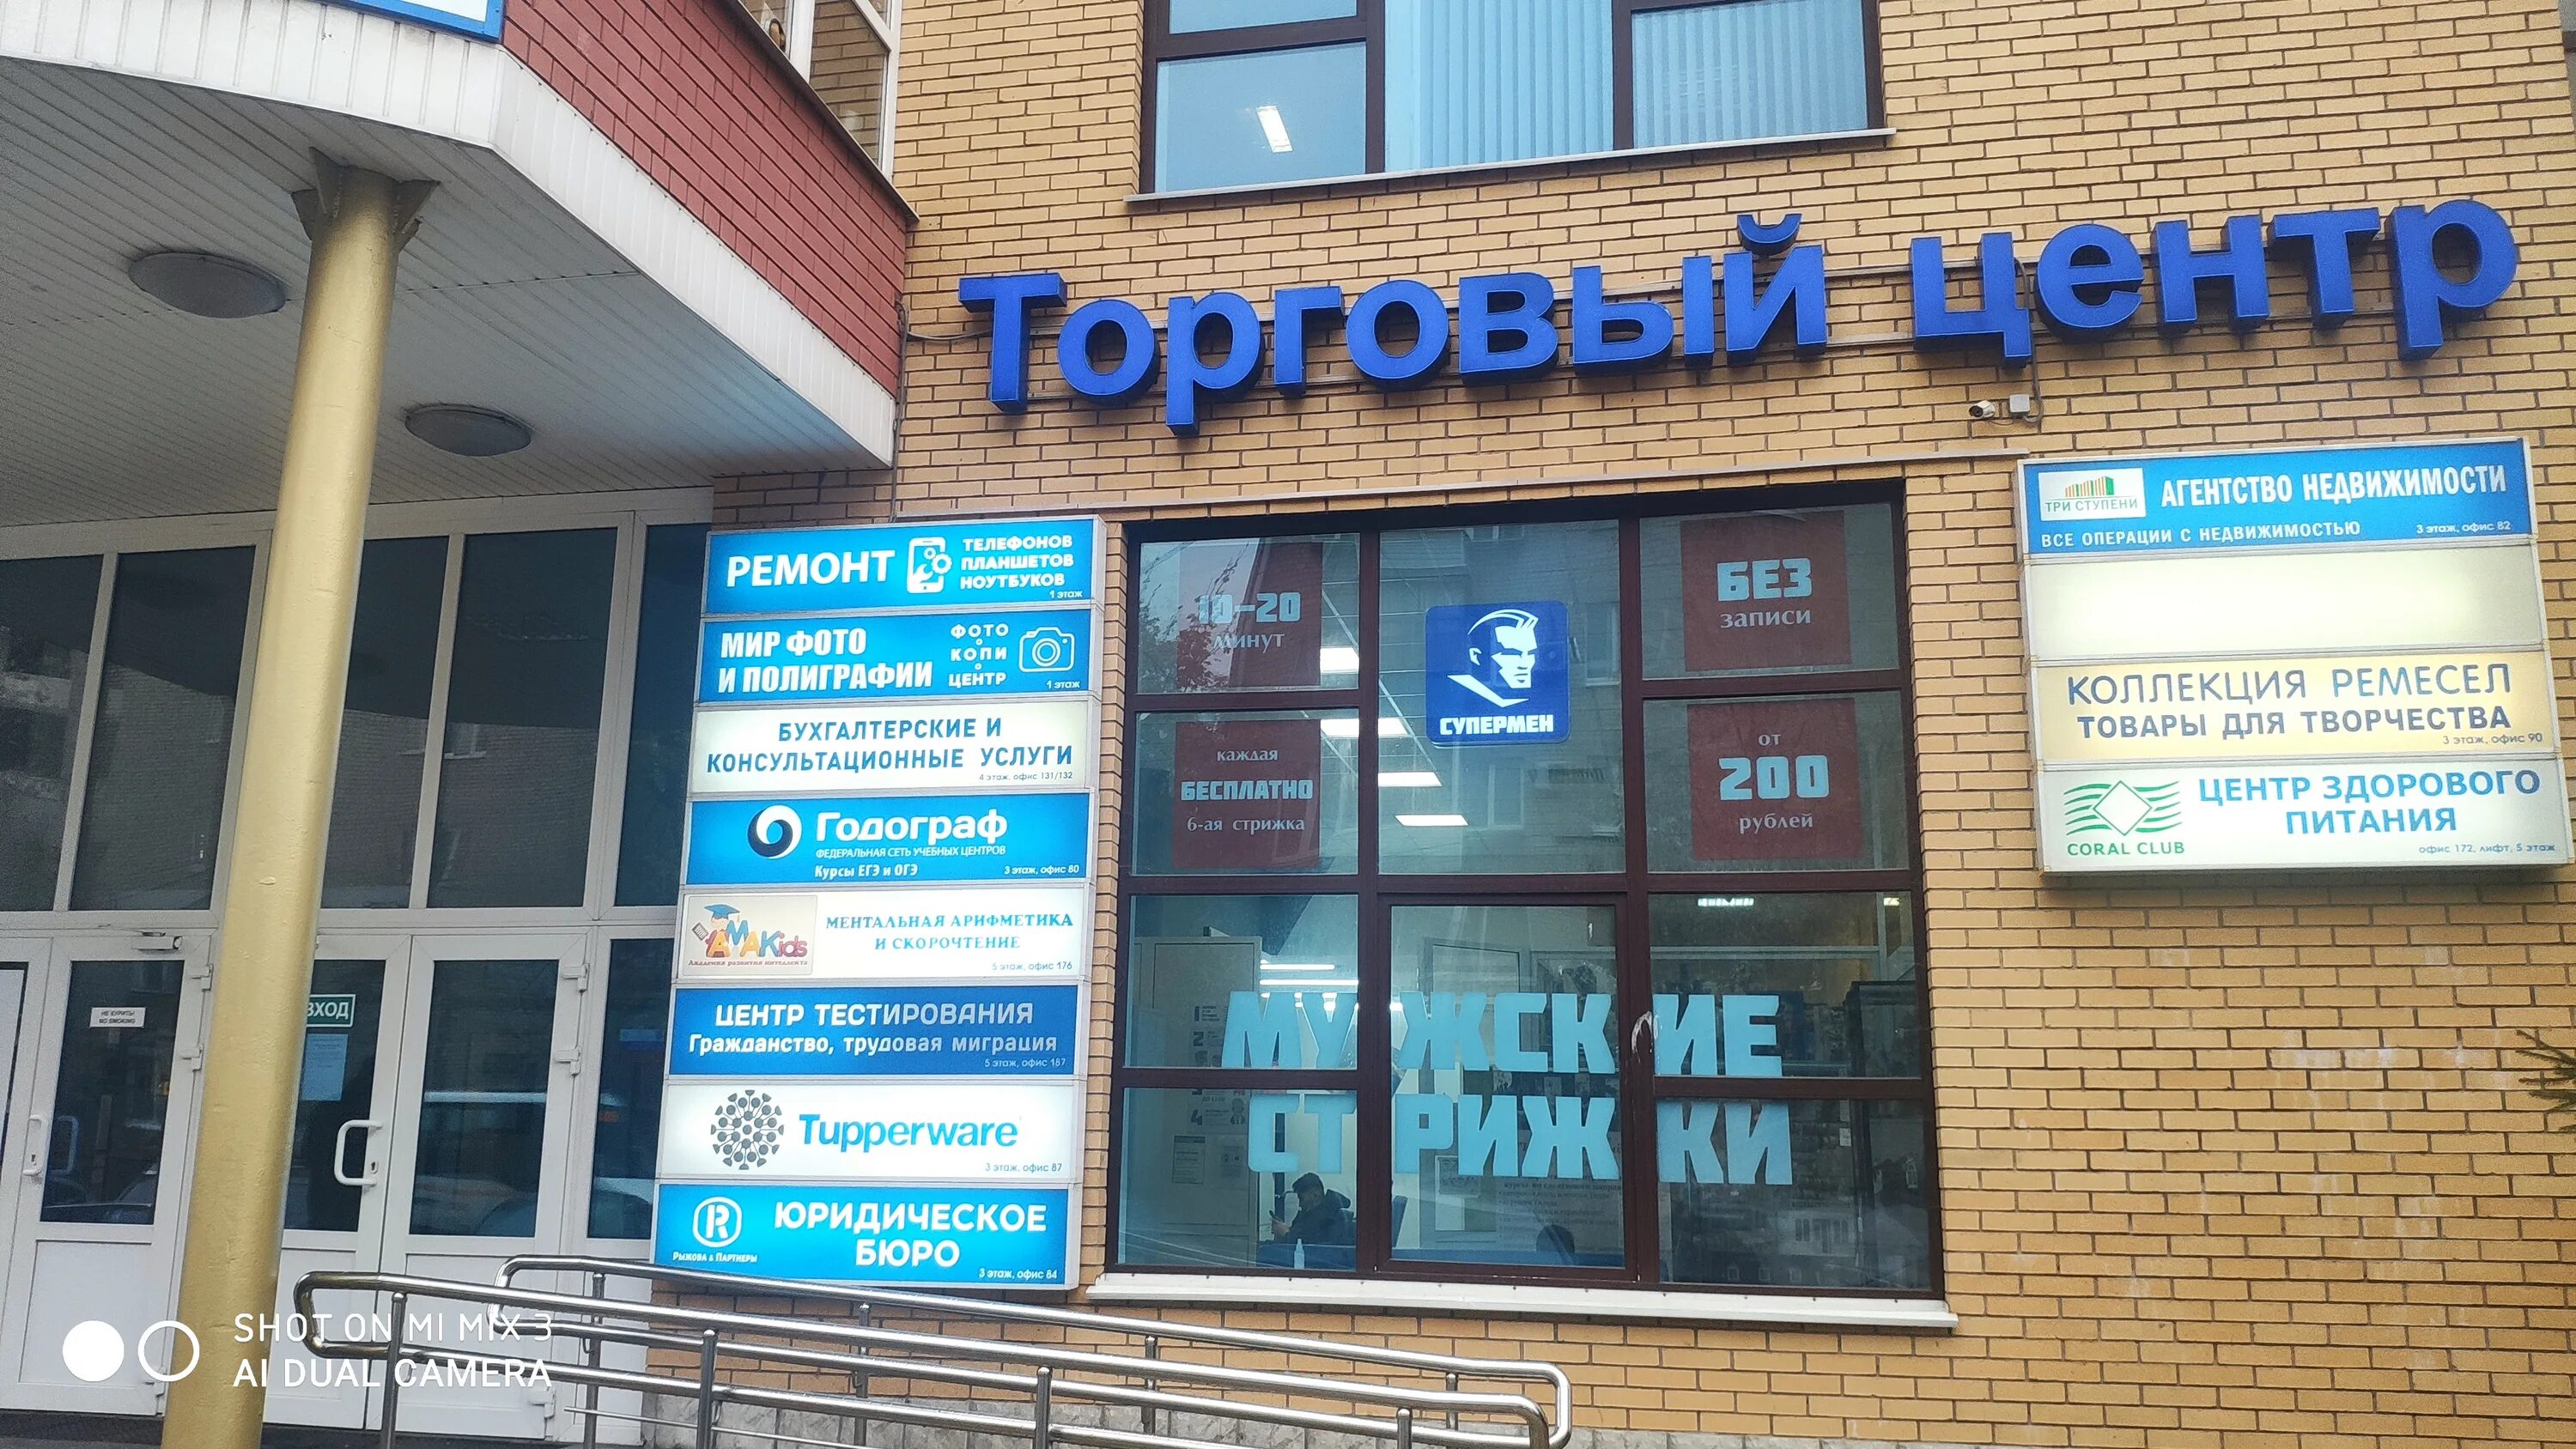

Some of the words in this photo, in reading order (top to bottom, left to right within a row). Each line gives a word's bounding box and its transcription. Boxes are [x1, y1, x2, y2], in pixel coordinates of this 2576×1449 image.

[958, 213, 1828, 436] Торговый
[1911, 198, 2519, 361] центр
[2160, 473, 2293, 508] АГЕНТСТВО
[2303, 465, 2507, 504] НЕДВИЖИМОСТИ
[2044, 500, 2072, 512] ТРИ
[2075, 496, 2139, 512] СТУПЕНИ
[2040, 533, 2075, 548] ВСЕ
[2082, 529, 2173, 548] ОПЕРАЦИИ
[2181, 528, 2192, 542] С
[2199, 520, 2361, 543] НЕДВИЖИМОСТЬЮ
[2416, 524, 2423, 534] 3
[2426, 524, 2459, 533] этаж,
[2462, 522, 2495, 532] офис
[963, 535, 1073, 552] ТЕЛЕФОНОВ
[726, 550, 896, 587] РЕМОНТ
[960, 554, 1074, 571] ПЛАНШЕТОВ
[960, 573, 1066, 590] НОУТБУКОВ
[1717, 558, 1813, 602] БЕЗ
[1049, 590, 1055, 598] 1
[1057, 590, 1084, 599] этаж
[1720, 609, 1811, 628] записи
[951, 623, 1010, 639] ФОТО
[721, 632, 781, 658] МИР
[787, 627, 866, 656] ФОТО
[1213, 634, 1285, 654] минут
[951, 646, 1008, 662] КОПИ
[718, 667, 736, 694] И
[742, 661, 933, 693] ПОЛИГРАФИИ
[948, 671, 1007, 688] ЦЕНТР
[1046, 681, 1053, 689] 1
[1054, 680, 1080, 689] этаж
[2068, 670, 2306, 705] КОЛЛЕКЦИЯ
[2332, 664, 2511, 698] РЕМЕСЕЛ
[778, 718, 975, 742] БУХГАЛТЕРСКИЕ
[986, 718, 1001, 736] И
[1440, 713, 1554, 736] СУПЕРМЕН
[2077, 713, 2207, 739] ТОВАРЫ
[2222, 712, 2285, 740] ДЛЯ
[2301, 706, 2512, 735] ТВОРЧЕСТВА
[1758, 734, 1782, 747] от
[2443, 736, 2450, 745] 3
[2453, 735, 2488, 746] этаж,
[2492, 733, 2524, 746] офис
[2527, 732, 2543, 743] 90
[707, 748, 963, 773] КОНСУЛЬТАЦИОННЫЕ
[980, 745, 1072, 768] УСЛУГИ
[1217, 748, 1279, 763] каждая
[1013, 773, 1037, 781] офис
[1041, 772, 1073, 780] 131/132
[1719, 755, 1830, 801] 200
[1181, 779, 1313, 802] БЕСПЛАТНО
[2199, 775, 2310, 805] ЦЕНТР
[2323, 769, 2541, 803] ЗДОРОВОГО
[817, 809, 1007, 849] Годограф
[1187, 817, 1223, 832] 6-ая
[1232, 817, 1305, 834] стрижка
[1739, 814, 1814, 835] рублей
[2287, 807, 2457, 835] ПИТАНИЯ
[816, 847, 886, 859] ФЕДЕРАЛЬНАЯ
[888, 847, 911, 858] СЕТЬ
[913, 846, 959, 858] УЧЕБНЫХ
[961, 845, 1006, 857] ЦЕНТРОВ
[2067, 842, 2131, 857] CORAL
[2136, 840, 2185, 855] CLUB
[2419, 845, 2451, 856] офис
[2516, 843, 2523, 853] 5
[2526, 843, 2555, 852] этаж
[815, 864, 854, 880] Курсы
[858, 864, 880, 876] ЕГЭ
[884, 866, 891, 876] и
[894, 864, 919, 876] ОГЭ
[1004, 865, 1011, 875] 3
[1012, 865, 1039, 875] этаж,
[1040, 865, 1066, 875] офис
[1068, 864, 1080, 874] 80
[825, 914, 945, 929] МЕНТАЛЬНАЯ
[950, 912, 1074, 928] АРИФМЕТИКА
[874, 937, 886, 950] И
[892, 936, 1020, 950] СКОРОЧТЕНИЕ
[1028, 961, 1054, 972] офис
[1056, 961, 1072, 970] 176
[714, 1004, 805, 1029] ЦЕНТР
[815, 1002, 1034, 1027] ТЕСТИРОВАНИЯ
[1221, 991, 1783, 1077] МУЖСКИЕ
[688, 1034, 835, 1056] Гражданство,
[843, 1034, 943, 1055] трудовая
[951, 1034, 1058, 1055] миграция
[984, 1058, 990, 1068] 5
[992, 1059, 1020, 1069] этаж,
[1022, 1058, 1048, 1069] офис
[1049, 1058, 1067, 1068] 187
[799, 1113, 1018, 1154] Tupperware
[1249, 1094, 1794, 1186] СТРИЖКИ
[985, 1162, 992, 1173] 3
[993, 1163, 1021, 1173] этаж,
[1023, 1163, 1049, 1174] офис
[1051, 1162, 1064, 1173] 87
[775, 1201, 1048, 1234] ЮРИДИЧЕСКОЕ
[855, 1240, 961, 1269] БЮРО
[979, 1268, 986, 1278] 3
[987, 1269, 1015, 1280] этаж,
[1017, 1269, 1044, 1281] офис
[1045, 1269, 1058, 1280] 84
